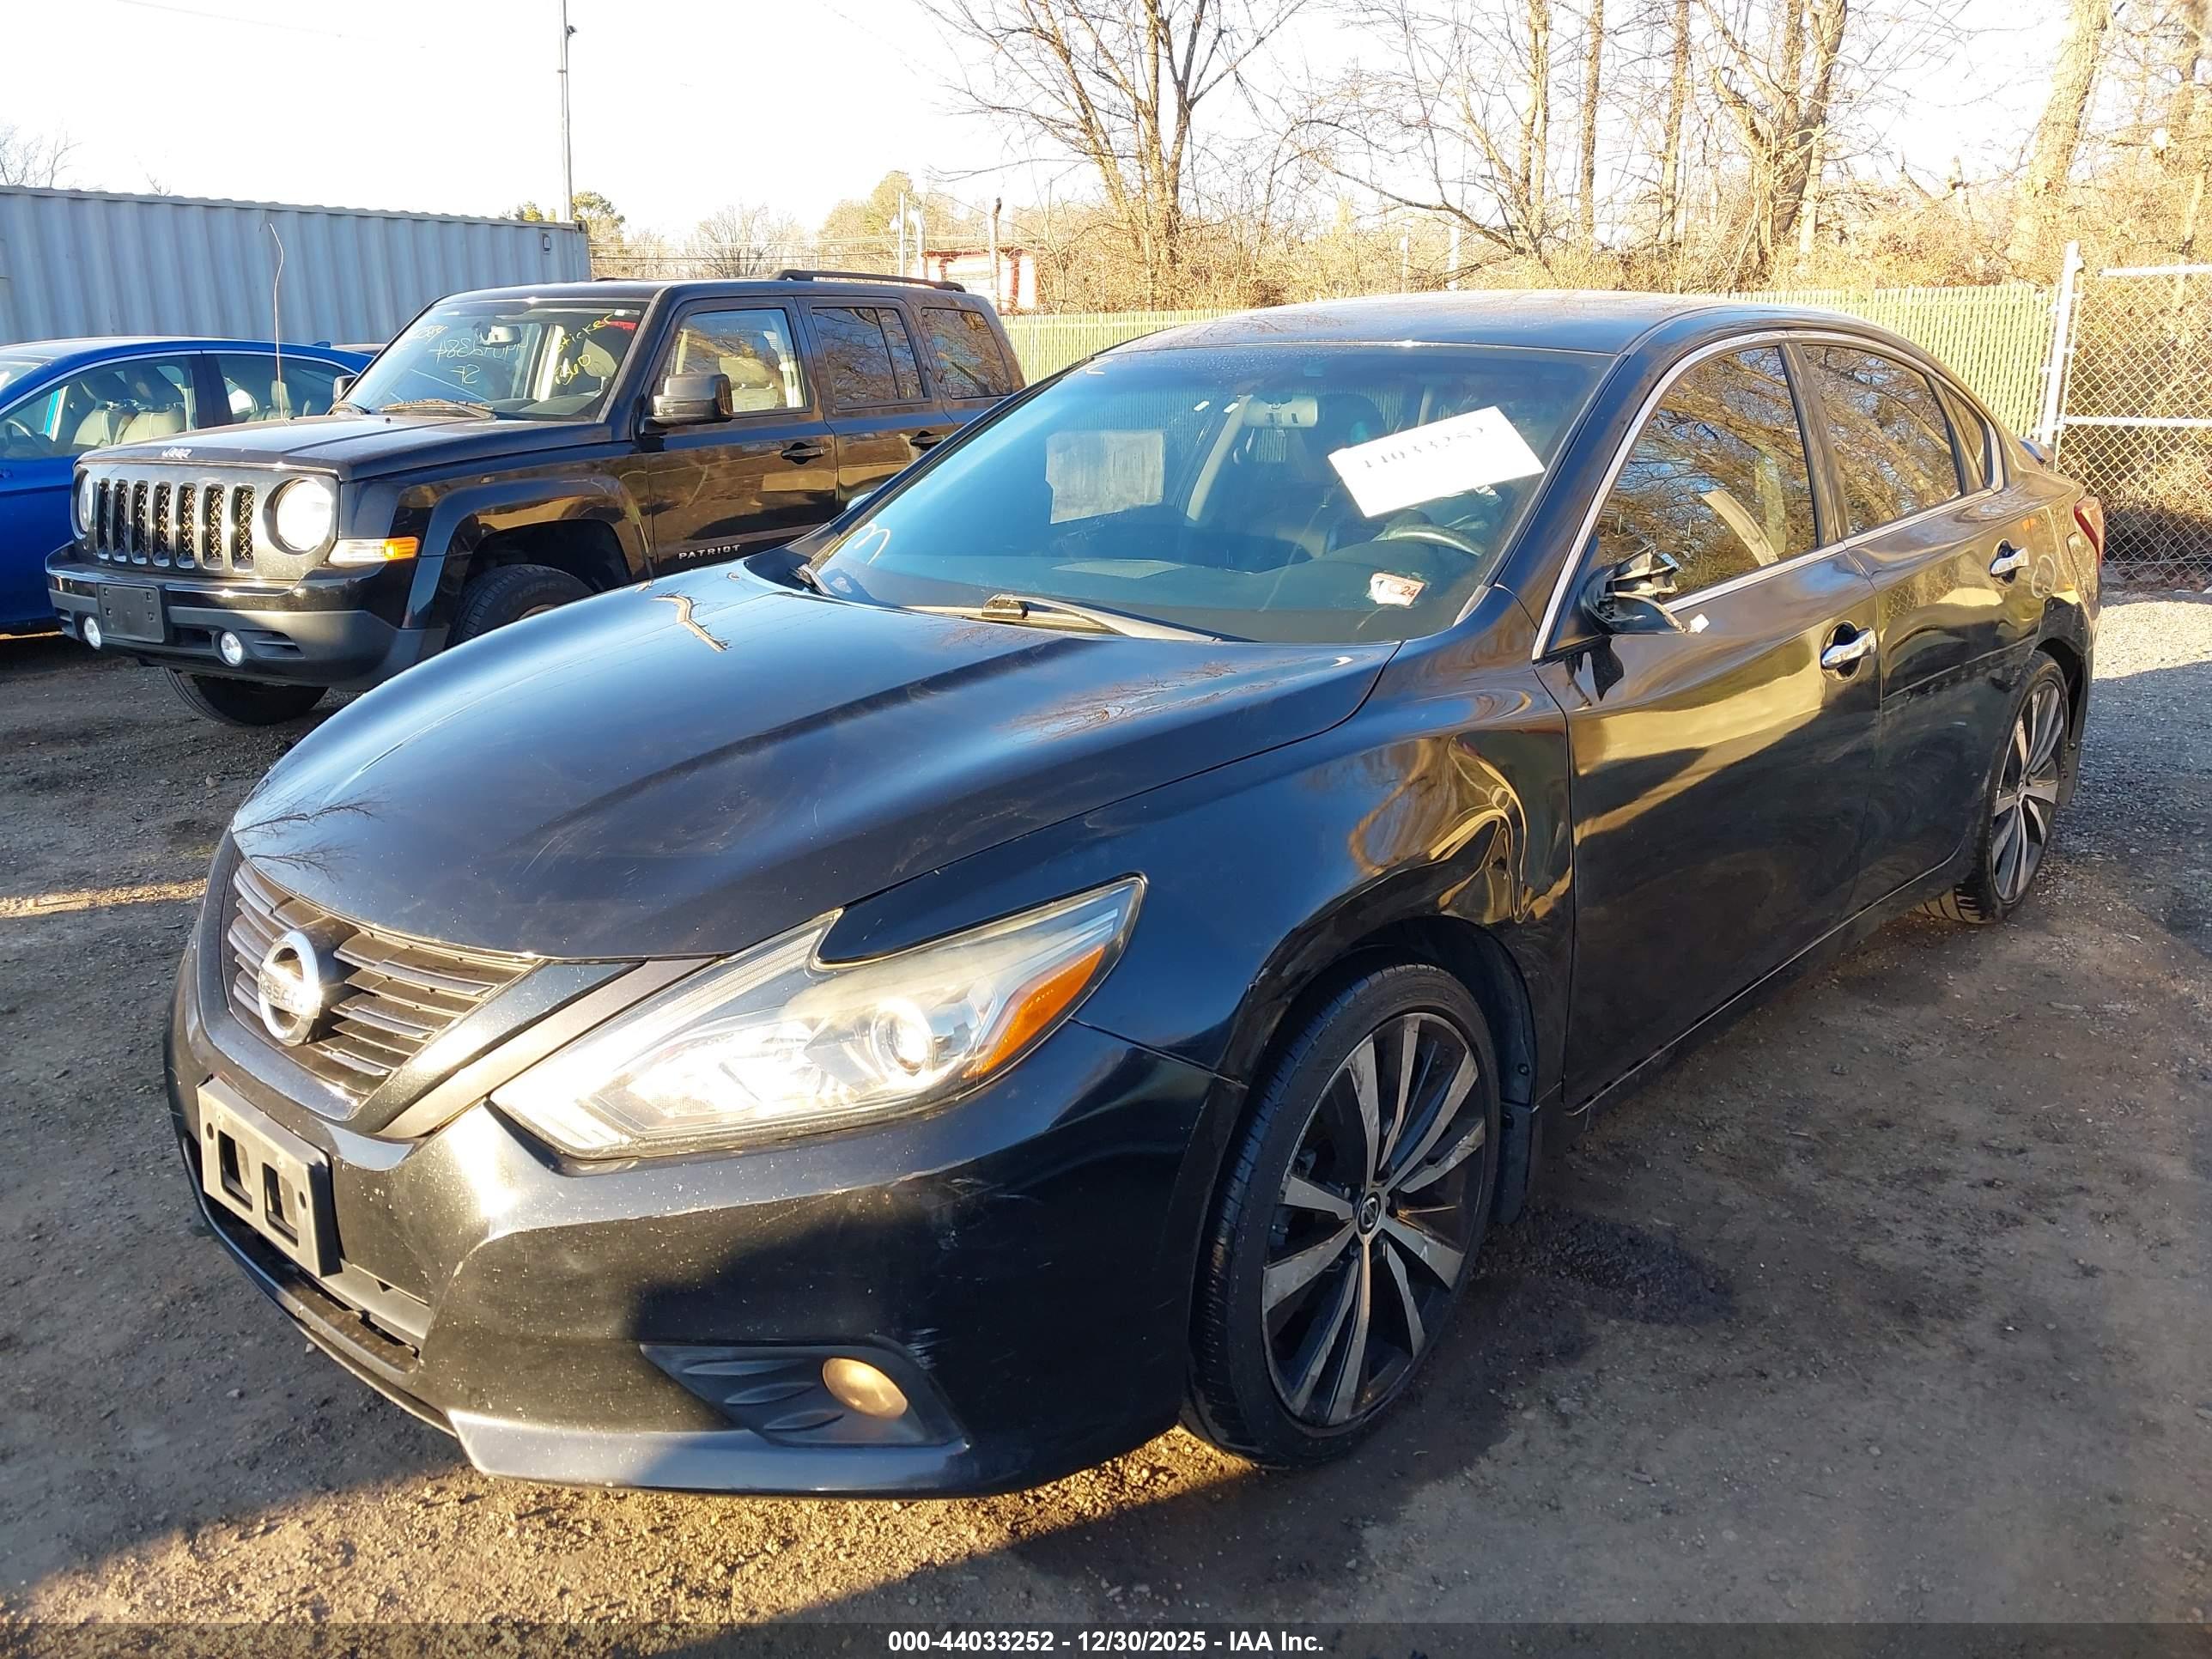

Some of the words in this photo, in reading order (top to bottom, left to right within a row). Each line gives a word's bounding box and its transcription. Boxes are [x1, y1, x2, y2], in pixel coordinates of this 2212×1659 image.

[161, 446, 193, 459] Jeep
[678, 544, 740, 560] PATRIOT
[1400, 586, 1418, 599] 24
